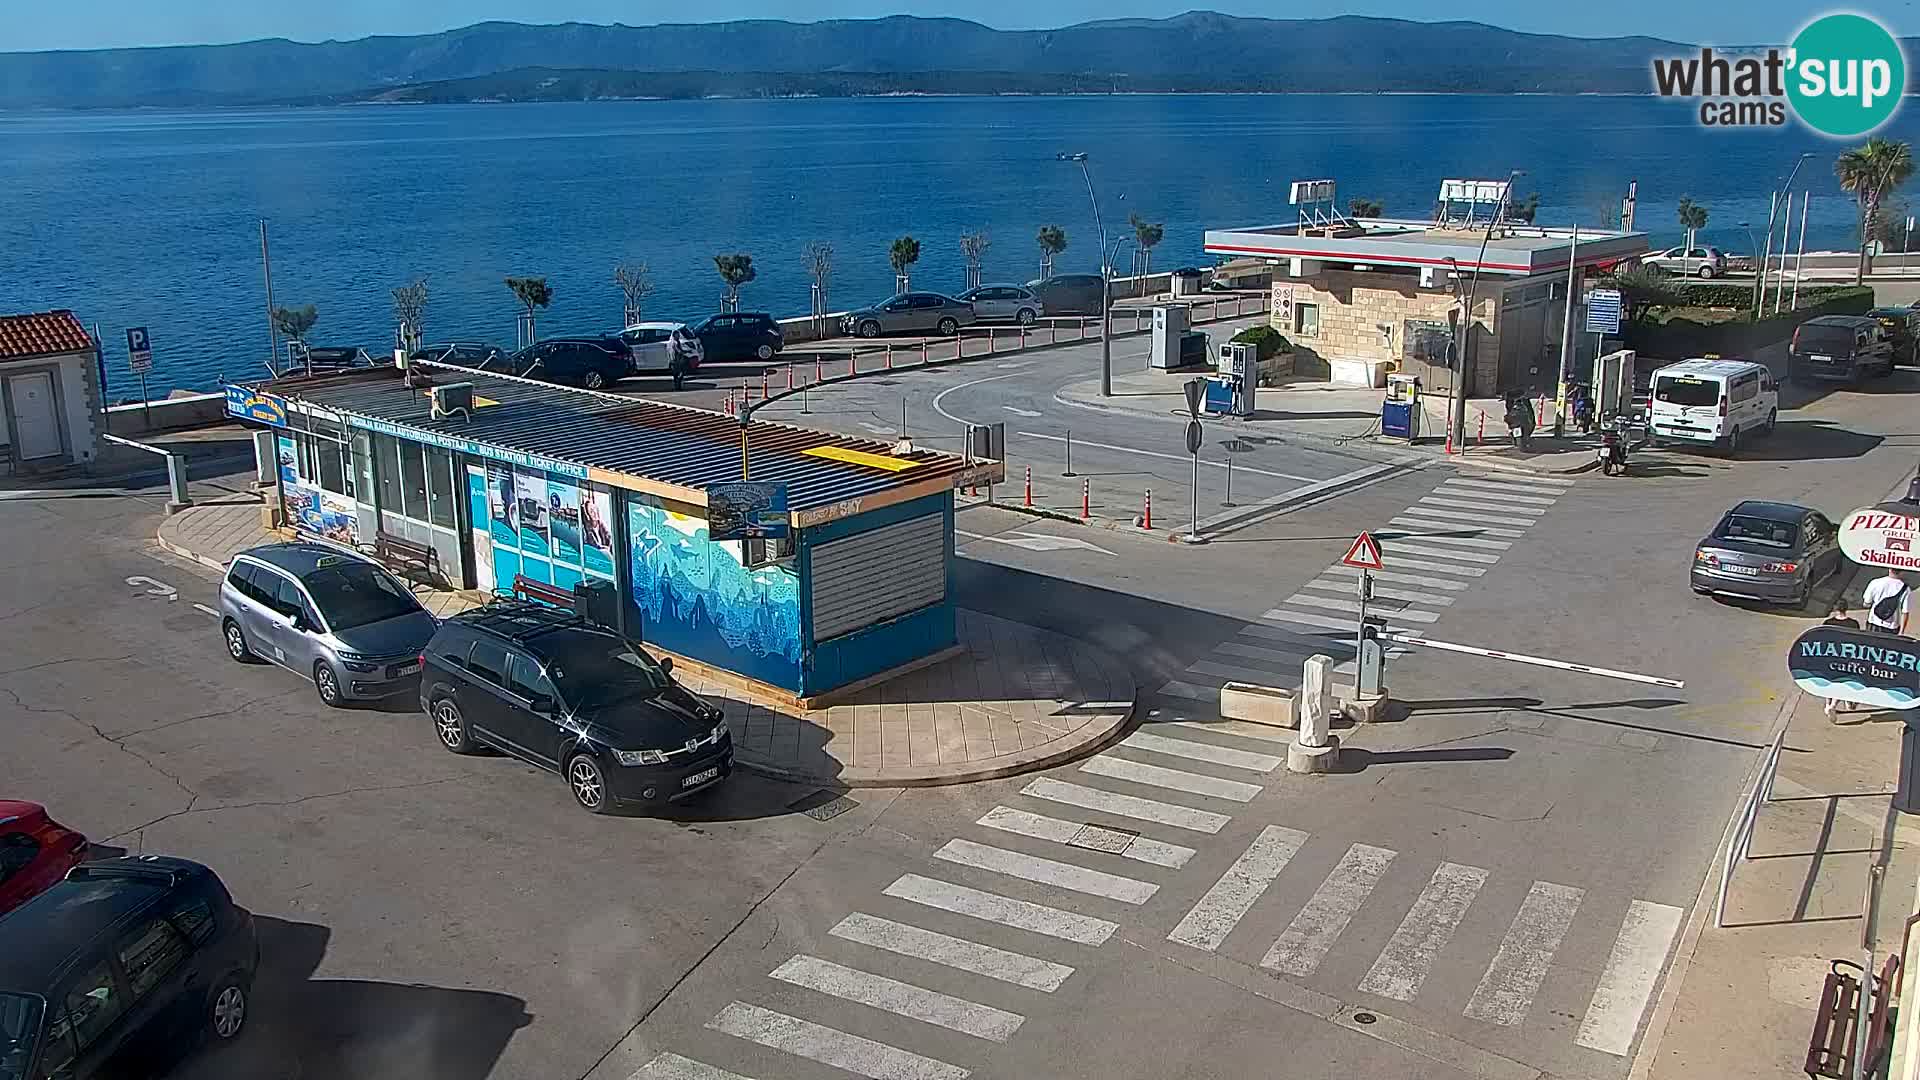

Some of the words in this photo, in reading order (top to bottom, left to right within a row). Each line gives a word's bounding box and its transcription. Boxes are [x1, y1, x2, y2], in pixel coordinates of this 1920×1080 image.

[131, 331, 144, 349] P
[397, 426, 438, 444] AUTOBUSNA
[438, 436, 469, 450] POSTAJA
[479, 445, 494, 457] BUS
[495, 447, 528, 465] STATION
[529, 456, 556, 471] TICKET
[556, 462, 584, 476] OFFICE
[839, 498, 863, 517] SKY
[1849, 514, 1920, 532] PIZZE
[1882, 529, 1917, 540] GRILL
[1829, 661, 1866, 675] caffe
[1871, 665, 1898, 680] bar
